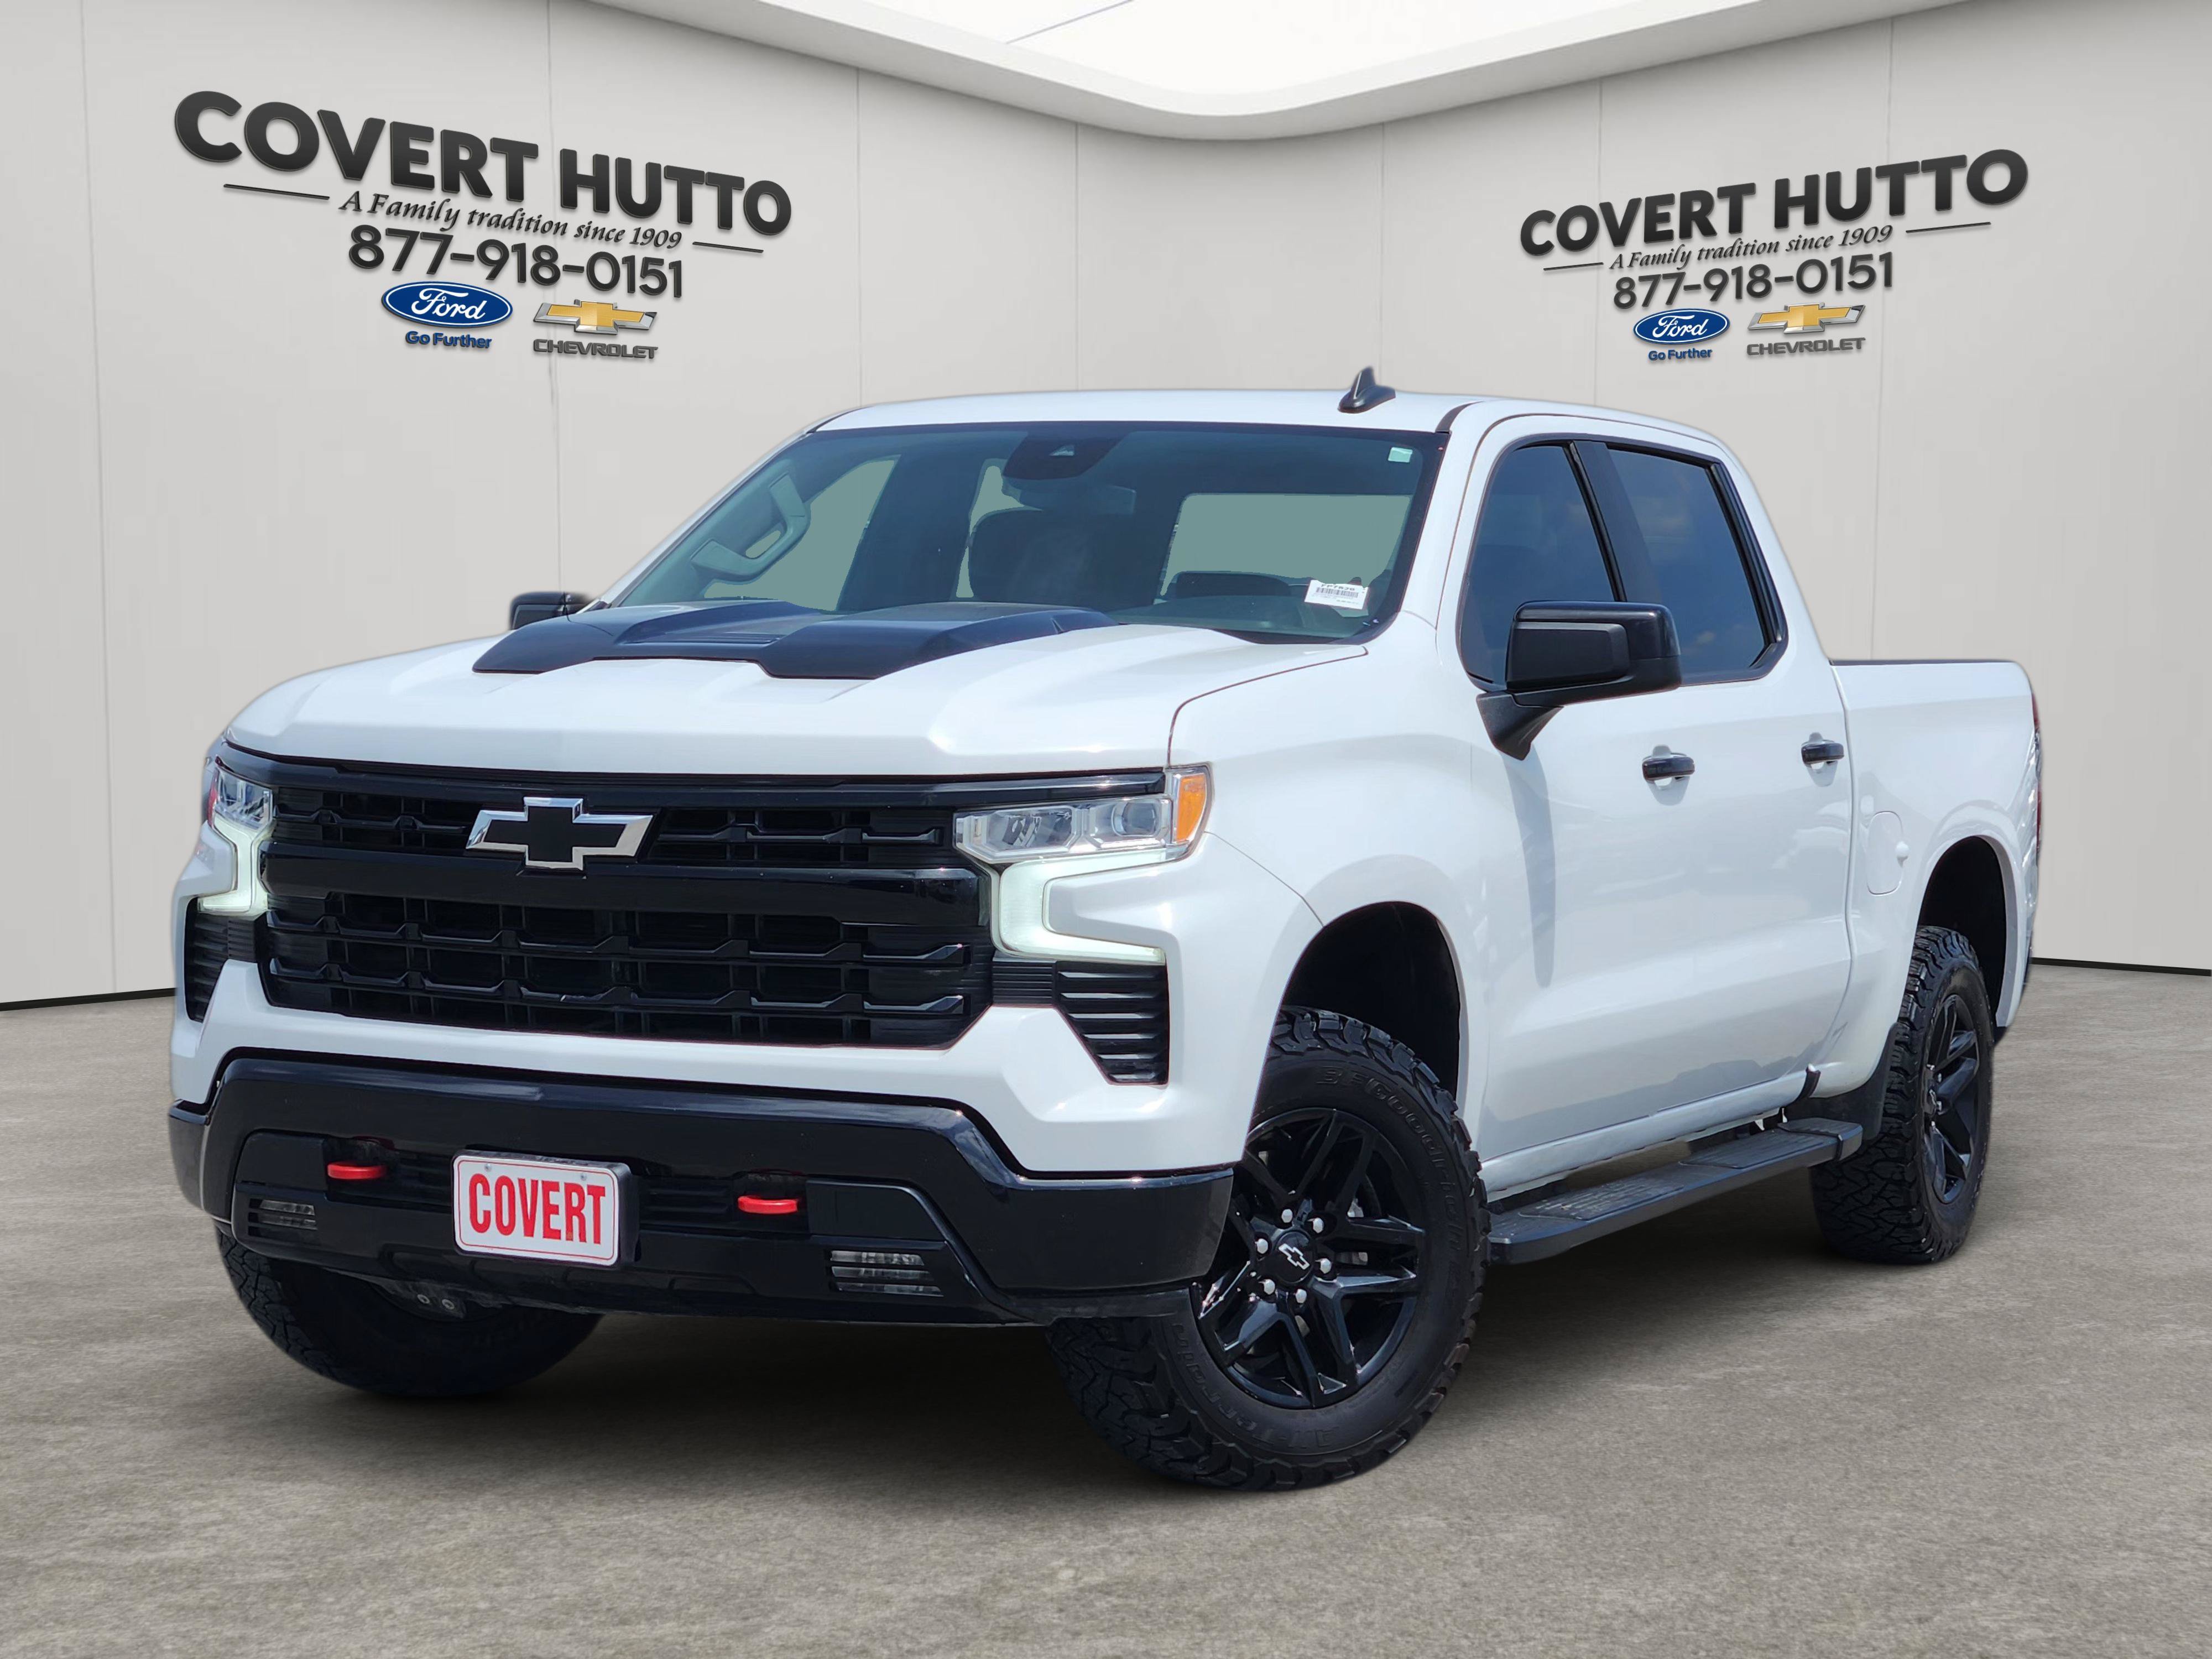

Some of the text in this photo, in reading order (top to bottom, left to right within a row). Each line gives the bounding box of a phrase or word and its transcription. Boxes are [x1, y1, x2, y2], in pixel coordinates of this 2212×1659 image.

[174, 91, 791, 236] COVERT HUTTO
[338, 191, 682, 249] A Family tradition since 1909
[1520, 149, 2028, 257] COVERT HUTTO
[348, 224, 682, 298] 877-918-0151
[1609, 225, 1893, 270] A Family tradition since 1909
[1614, 251, 1892, 309] 877-918-0151
[411, 288, 487, 320] Ford
[1652, 315, 1709, 338] Ford
[405, 331, 492, 349] Go Further
[533, 338, 659, 359] CHEVROLET
[1648, 348, 1713, 361] Go Further
[1746, 337, 1866, 356] CHEVROLET
[468, 1173, 606, 1245] COVERT
